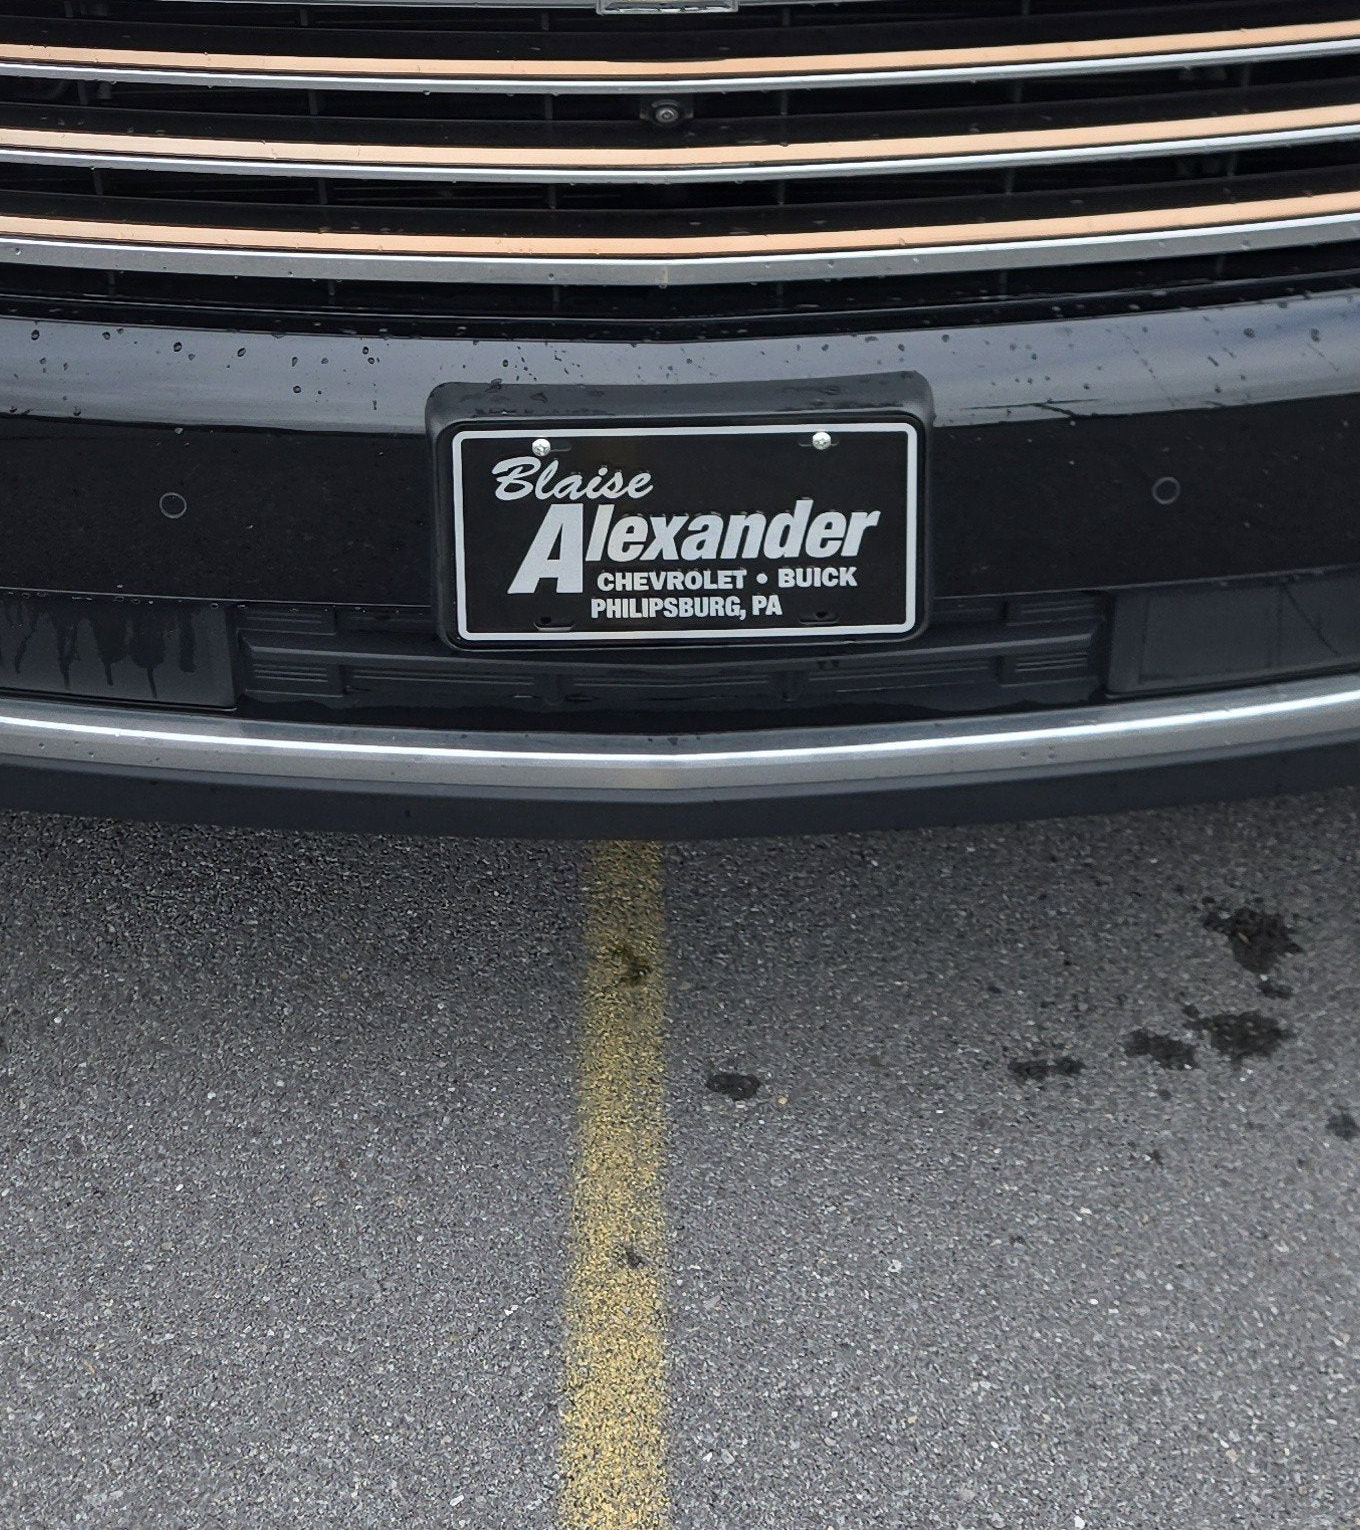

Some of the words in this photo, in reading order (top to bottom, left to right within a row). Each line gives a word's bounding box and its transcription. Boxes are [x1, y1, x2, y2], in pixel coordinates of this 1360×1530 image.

[491, 456, 654, 502] Blaise
[506, 499, 882, 595] Alexander
[597, 568, 748, 592] CHEVROLET
[777, 566, 858, 589] BUICK
[590, 595, 747, 621] PHILIPSBURG,
[751, 594, 783, 616] PA
